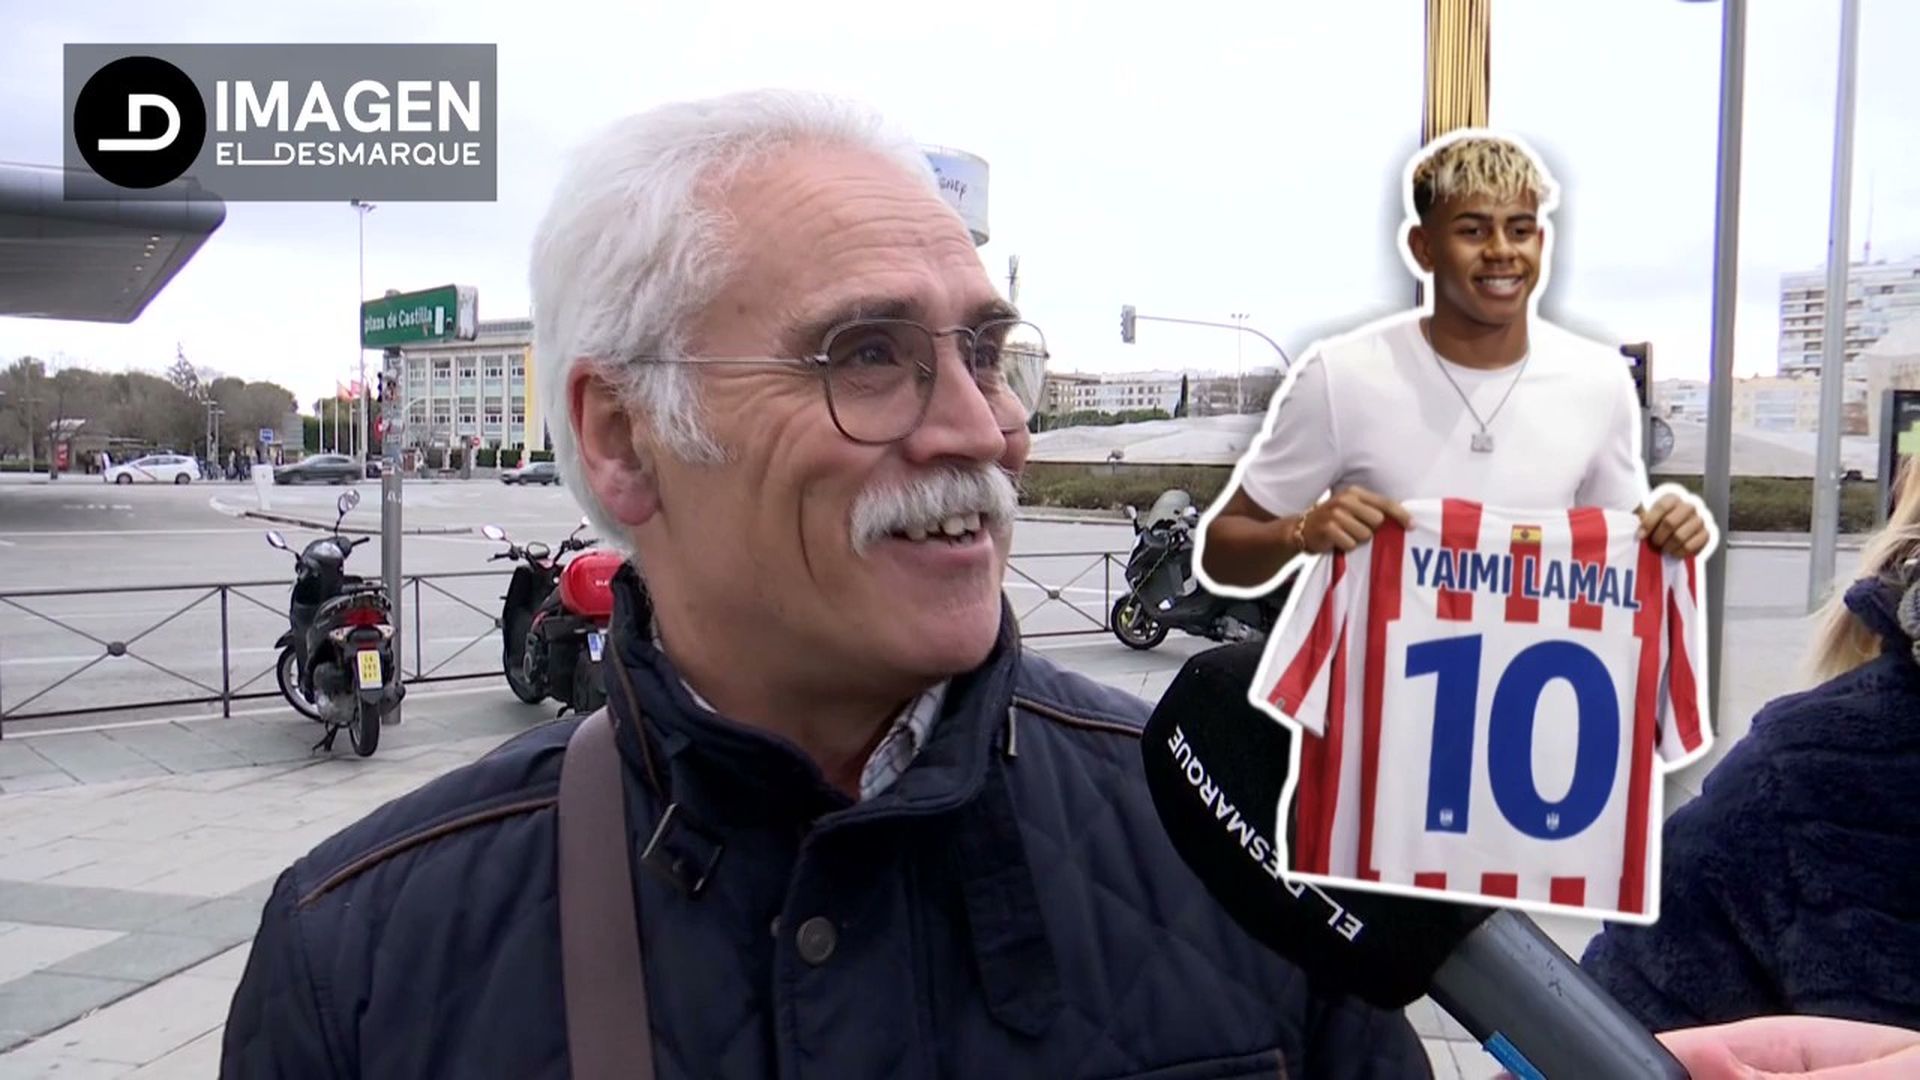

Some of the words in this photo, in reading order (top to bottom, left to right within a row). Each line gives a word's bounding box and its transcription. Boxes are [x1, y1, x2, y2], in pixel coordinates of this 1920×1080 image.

[387, 311, 397, 329] de
[398, 306, 433, 327] Castilla
[1411, 547, 1512, 594] YAIMI
[1524, 558, 1640, 609] LAMAL
[1405, 634, 1620, 840] 10
